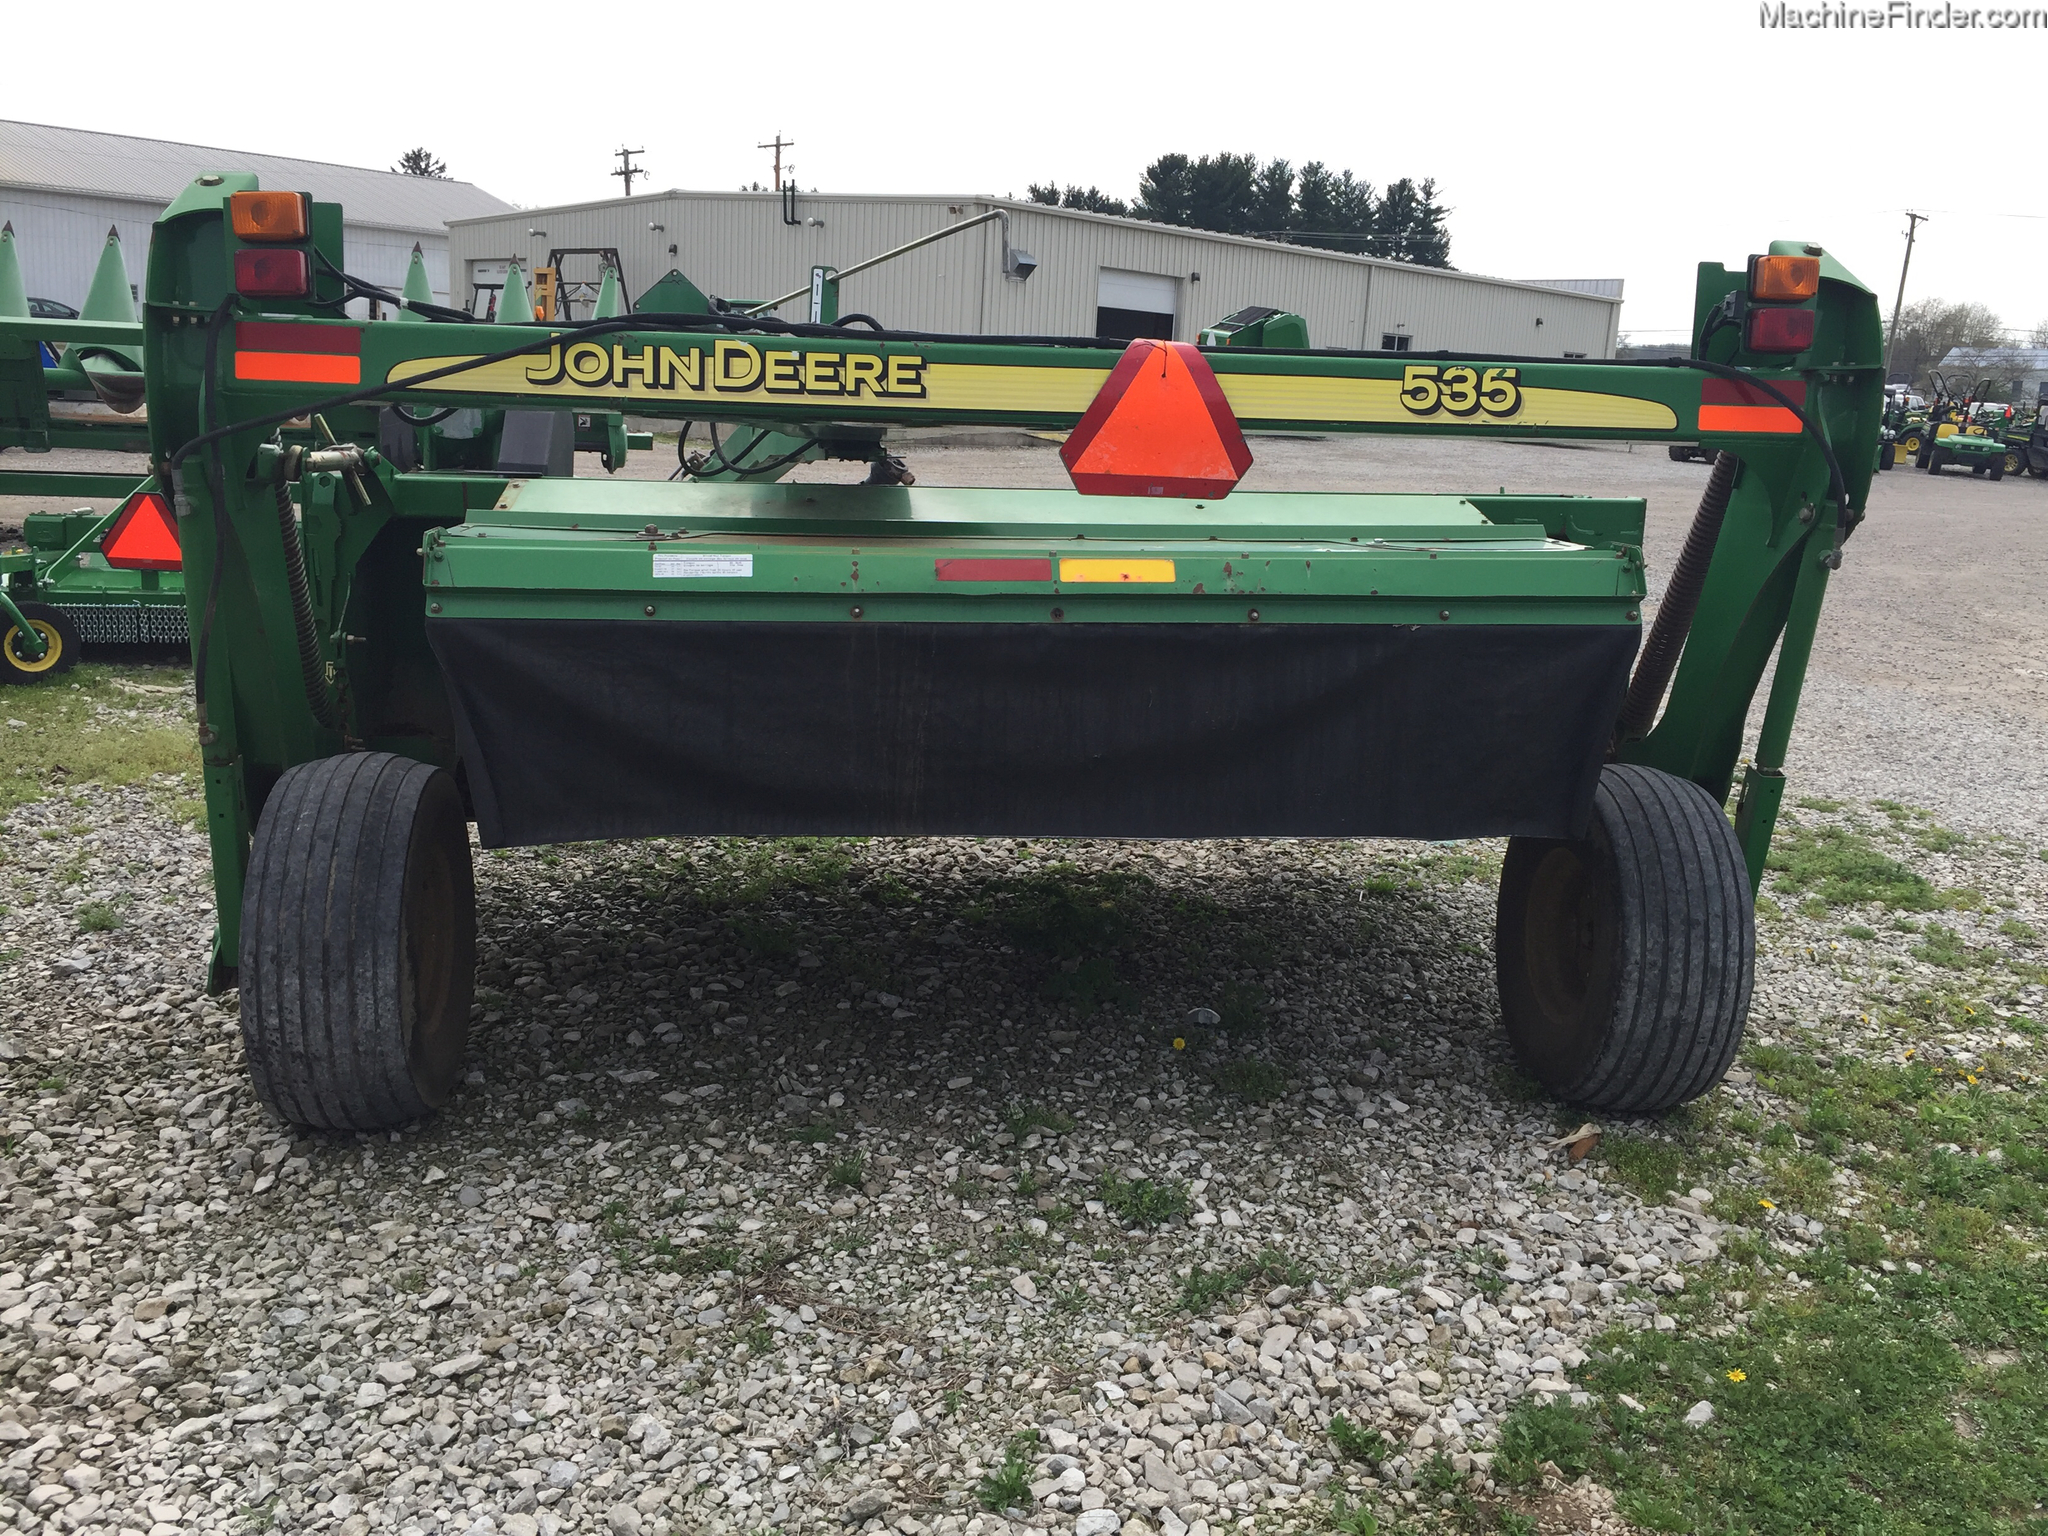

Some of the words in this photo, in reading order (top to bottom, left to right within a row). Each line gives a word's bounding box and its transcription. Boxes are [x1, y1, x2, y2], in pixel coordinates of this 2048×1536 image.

[526, 332, 705, 391] JOHN
[714, 339, 927, 398] DEERE
[1400, 365, 1521, 417] 535
